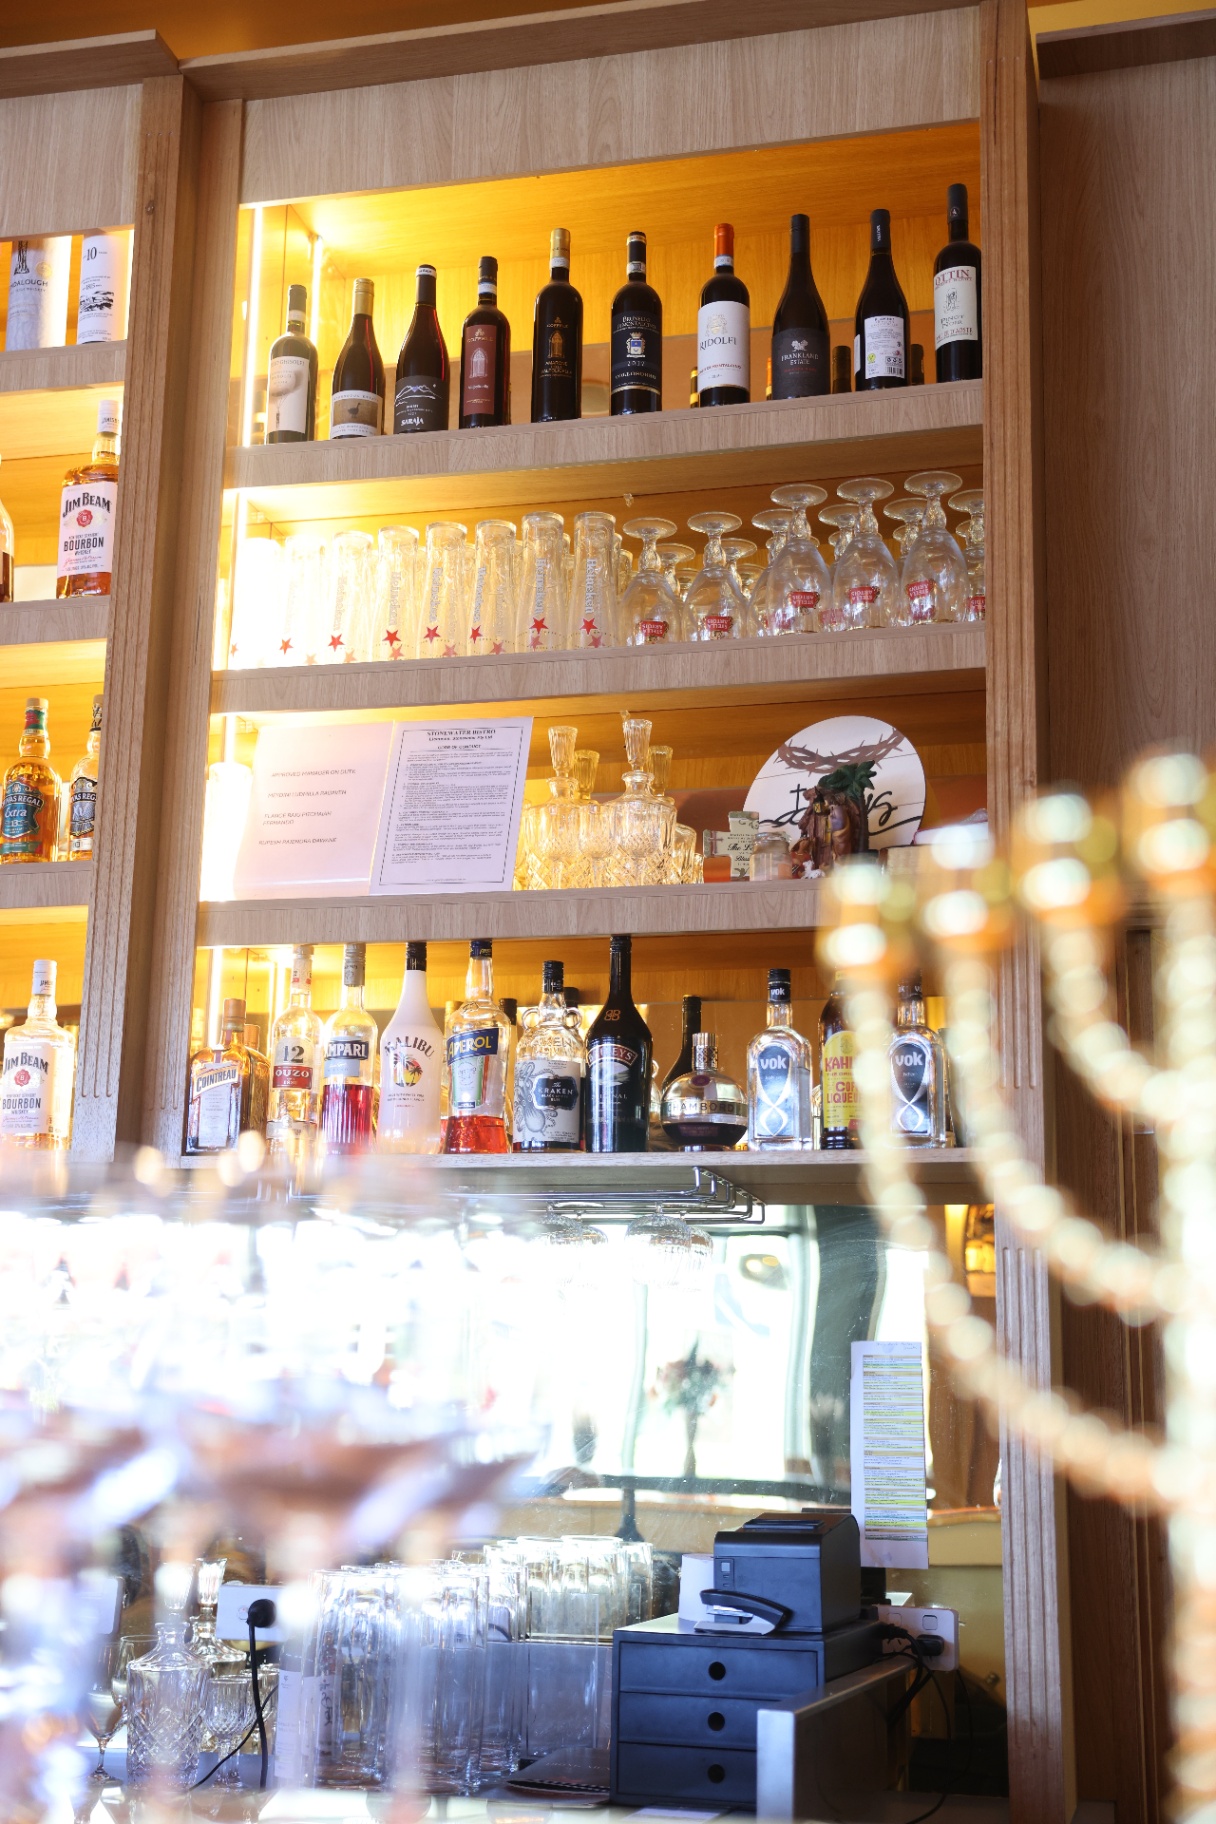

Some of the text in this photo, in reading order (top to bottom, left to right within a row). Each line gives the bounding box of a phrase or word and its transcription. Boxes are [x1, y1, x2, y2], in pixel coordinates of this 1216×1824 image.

[86, 246, 97, 261] 10
[935, 269, 970, 286] OTTIN
[700, 336, 737, 351] RIDOLFI
[781, 352, 819, 362] FRANKLAND
[63, 491, 112, 518] JIM BEAM
[63, 537, 104, 552] BOURBON
[535, 558, 547, 614] Heineken
[585, 558, 597, 614] Heineken
[18, 795, 41, 807] REGAL
[5, 805, 28, 818] Extra
[770, 987, 785, 996] vok
[384, 1035, 435, 1058] MALIBU
[448, 1035, 492, 1060] APEROL
[283, 1045, 305, 1064] 12
[760, 1054, 787, 1070] vok
[895, 1051, 924, 1067] vok
[3, 1051, 49, 1076] JIM BEAM
[196, 1068, 237, 1093] COINTREAU
[275, 1068, 310, 1078] OUZO
[537, 1087, 573, 1095] KRAKEN
[2, 1097, 42, 1110] BOURBON
[667, 1102, 735, 1113] CHAMBORD
